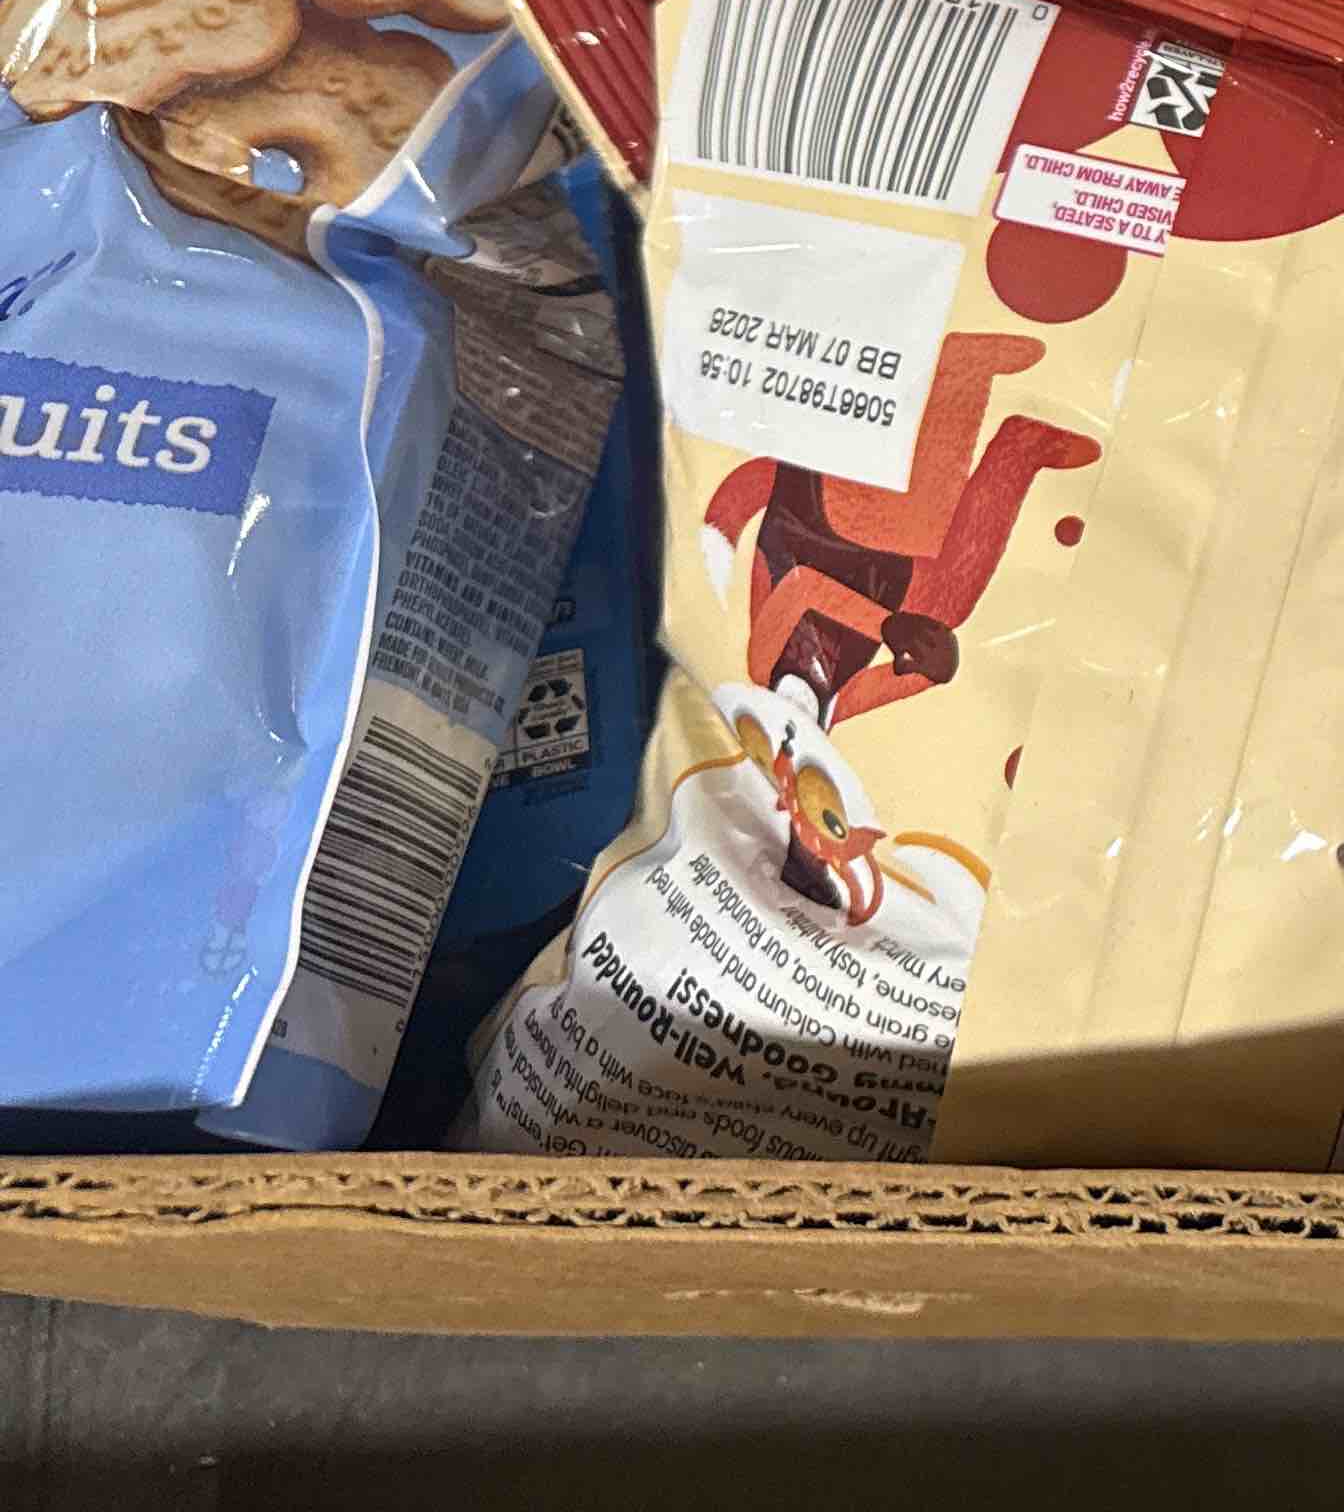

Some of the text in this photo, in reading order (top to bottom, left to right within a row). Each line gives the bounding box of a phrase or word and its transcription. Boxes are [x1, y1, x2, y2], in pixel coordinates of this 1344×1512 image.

[1024, 155, 1170, 196] AWAY FROM CHILD.
[1073, 191, 1122, 212] CHILD.
[1051, 202, 1151, 238] TO A SEATED,
[764, 321, 819, 361] MAR
[819, 337, 852, 369] 07
[856, 345, 902, 381] BB
[581, 932, 746, 1086] Well-Rounded
